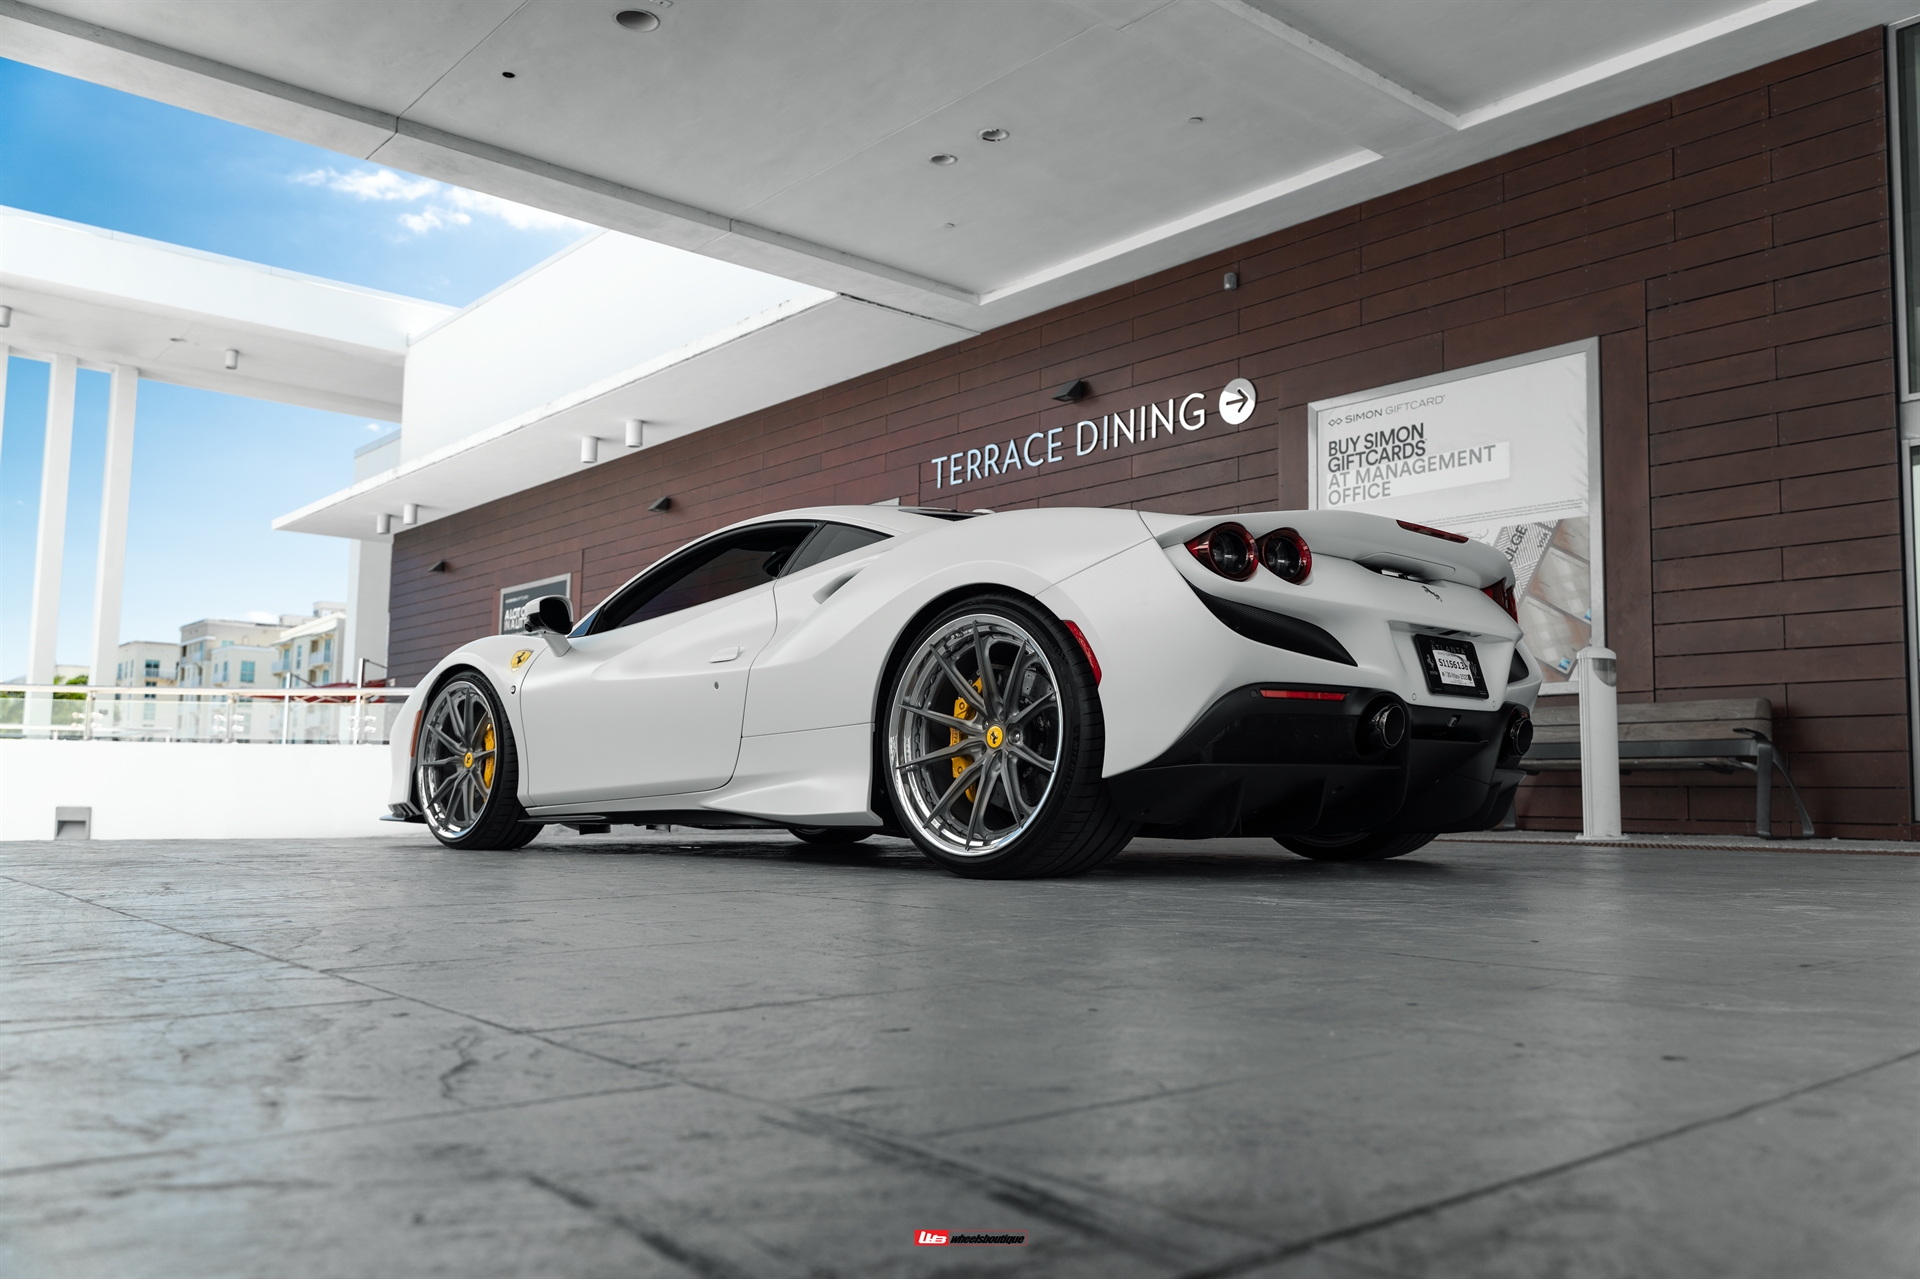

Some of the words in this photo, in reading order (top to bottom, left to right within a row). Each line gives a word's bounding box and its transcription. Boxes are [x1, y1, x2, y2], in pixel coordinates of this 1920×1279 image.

[1345, 408, 1383, 424] SIMON
[931, 427, 1064, 489] TERRACE
[1076, 392, 1206, 457] DINING
[1328, 435, 1361, 457] BUY
[1364, 423, 1424, 449] SIMON
[1328, 472, 1351, 490] AT
[1356, 445, 1496, 485] MANAGEMENT
[1328, 481, 1391, 506] OFFICE
[1504, 525, 1528, 561] ULGE
[1537, 532, 1549, 549] VISA
[1431, 644, 1466, 654] ATLANTA
[1061, 740, 1079, 797] MICHELIN
